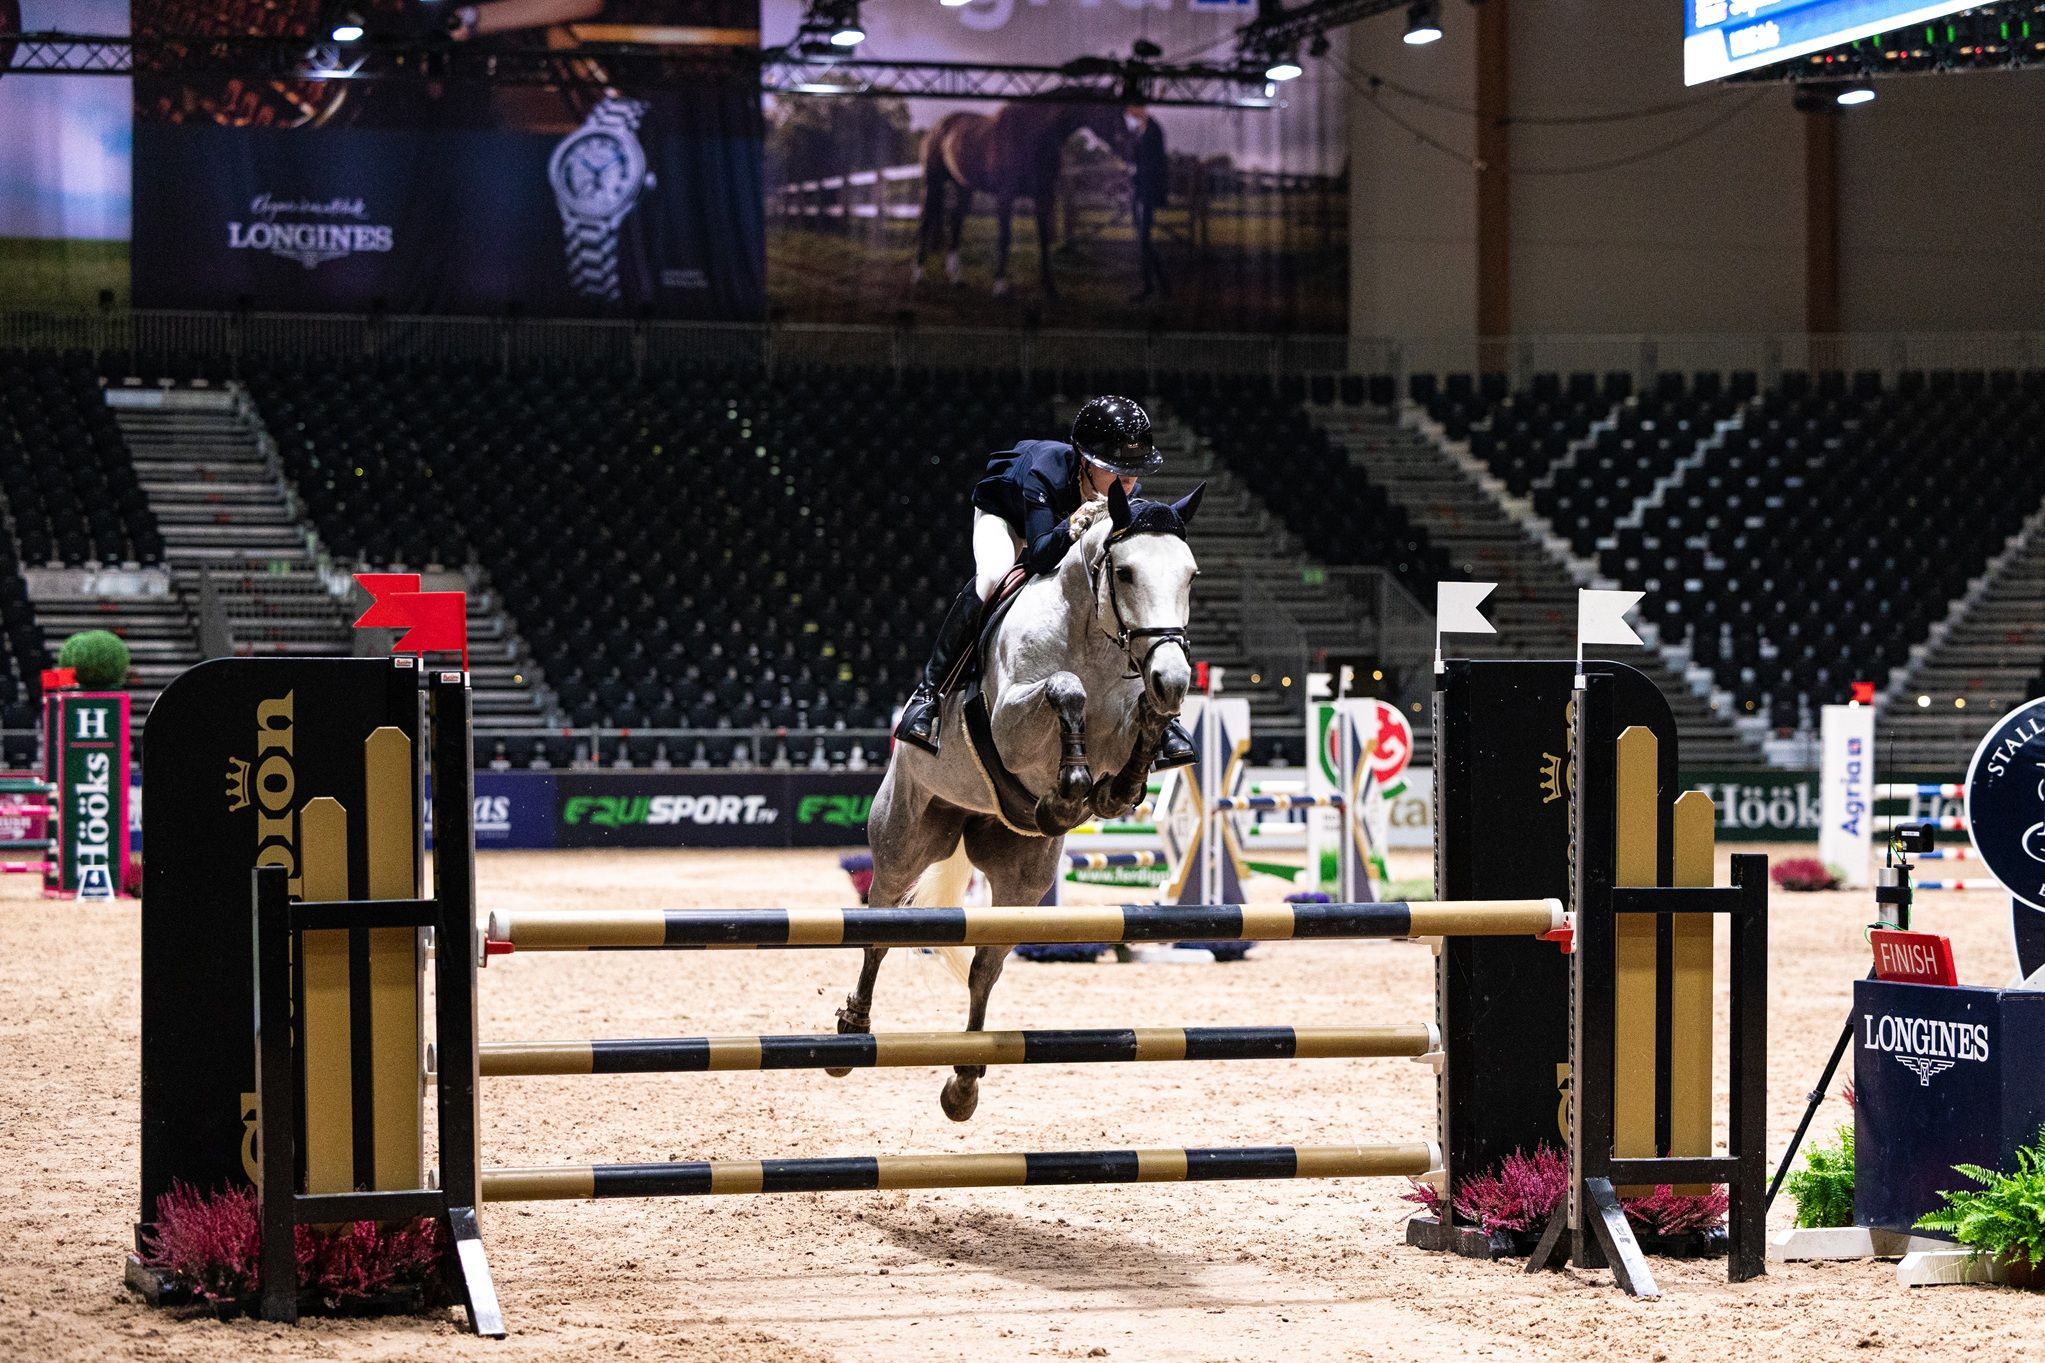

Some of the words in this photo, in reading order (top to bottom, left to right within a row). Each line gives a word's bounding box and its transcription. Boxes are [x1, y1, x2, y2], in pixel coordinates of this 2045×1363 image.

[226, 221, 394, 252] LONGINES
[76, 708, 109, 738] H
[1987, 717, 2045, 777] STALL
[74, 752, 110, 881] Hööks
[1694, 782, 1822, 829] Höök
[1841, 761, 1865, 837] Agria
[1880, 943, 1938, 975] FINISH
[1864, 1014, 1989, 1062] LONGINES
